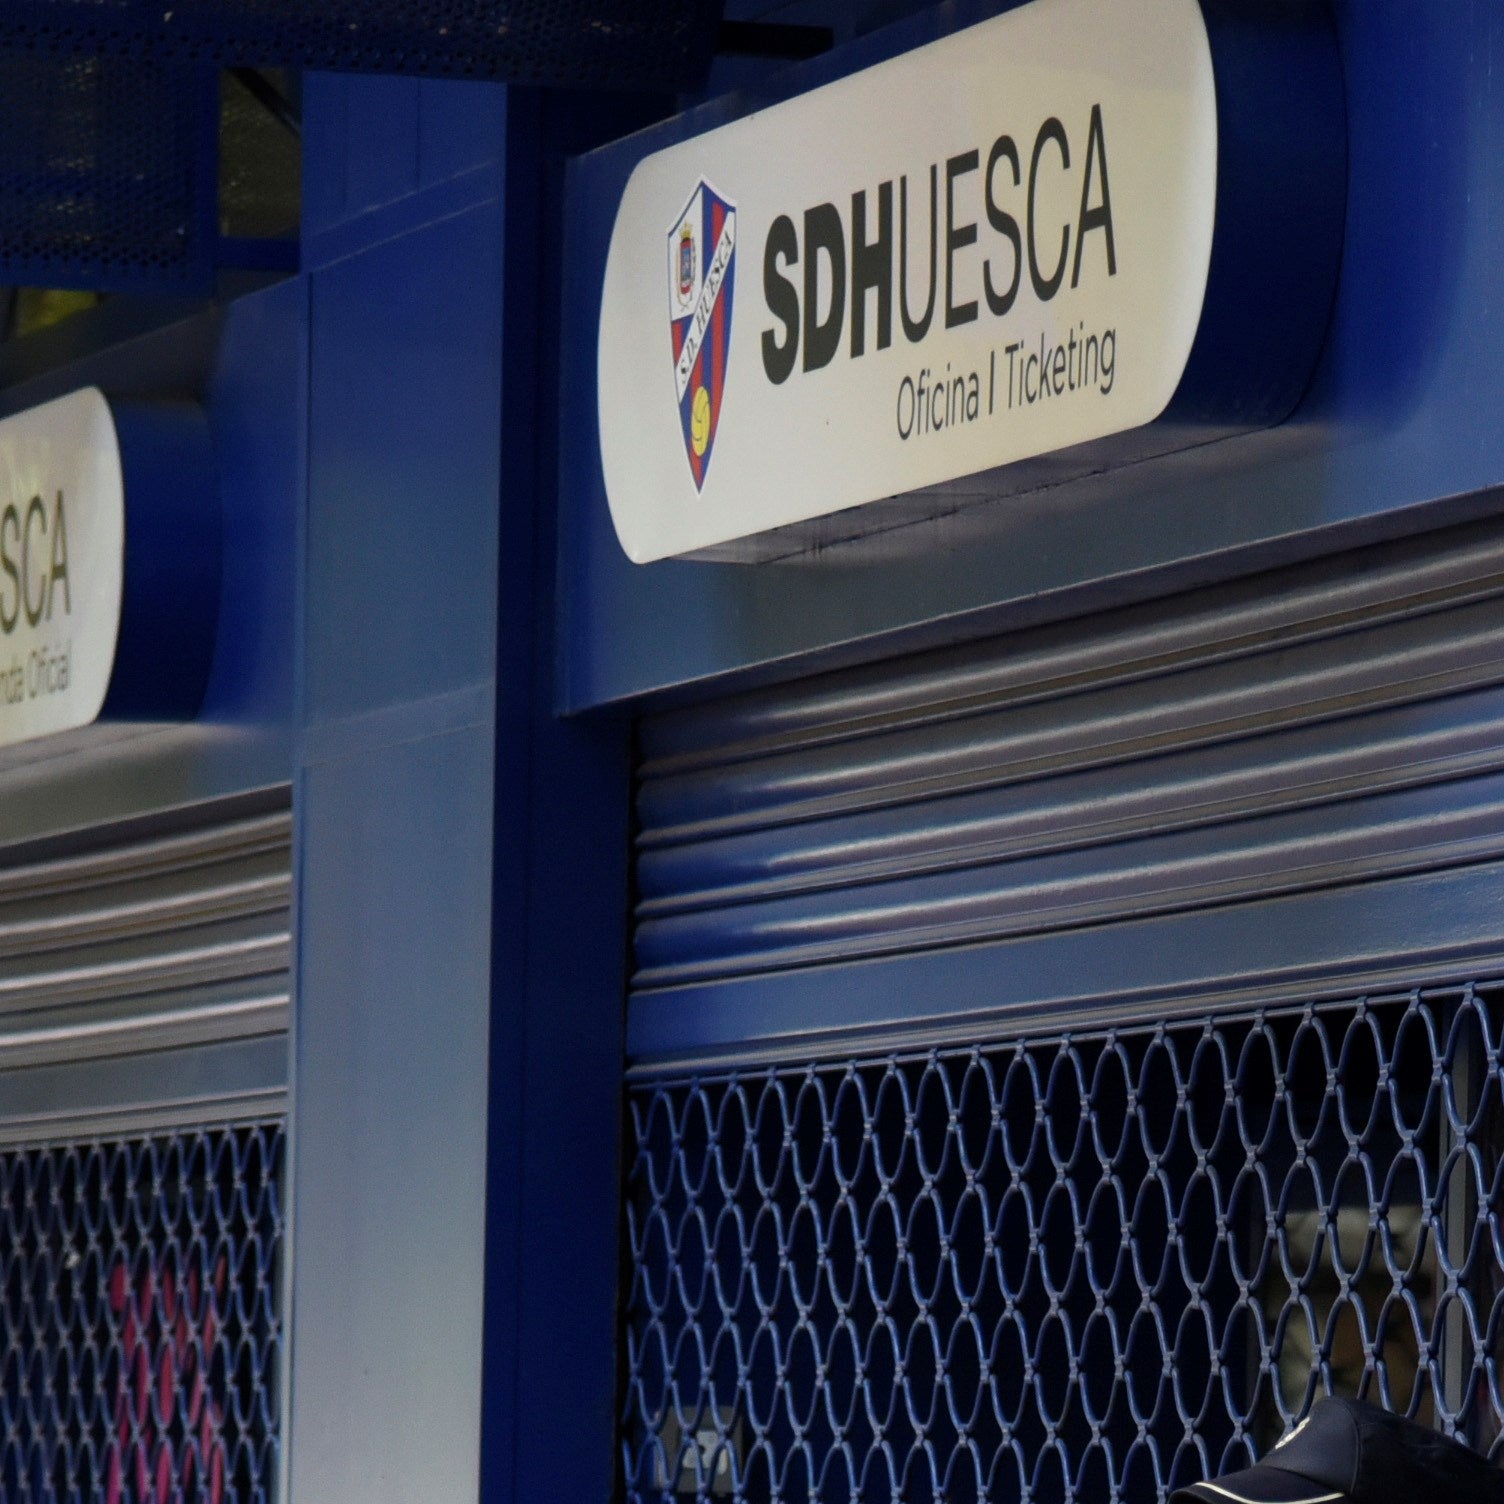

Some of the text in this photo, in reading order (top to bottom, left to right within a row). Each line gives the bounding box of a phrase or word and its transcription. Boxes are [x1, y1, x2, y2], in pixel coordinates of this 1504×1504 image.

[760, 103, 1118, 386] SDHUESCA
[897, 362, 979, 440] Oficina
[1005, 320, 1116, 409] Ticketing
